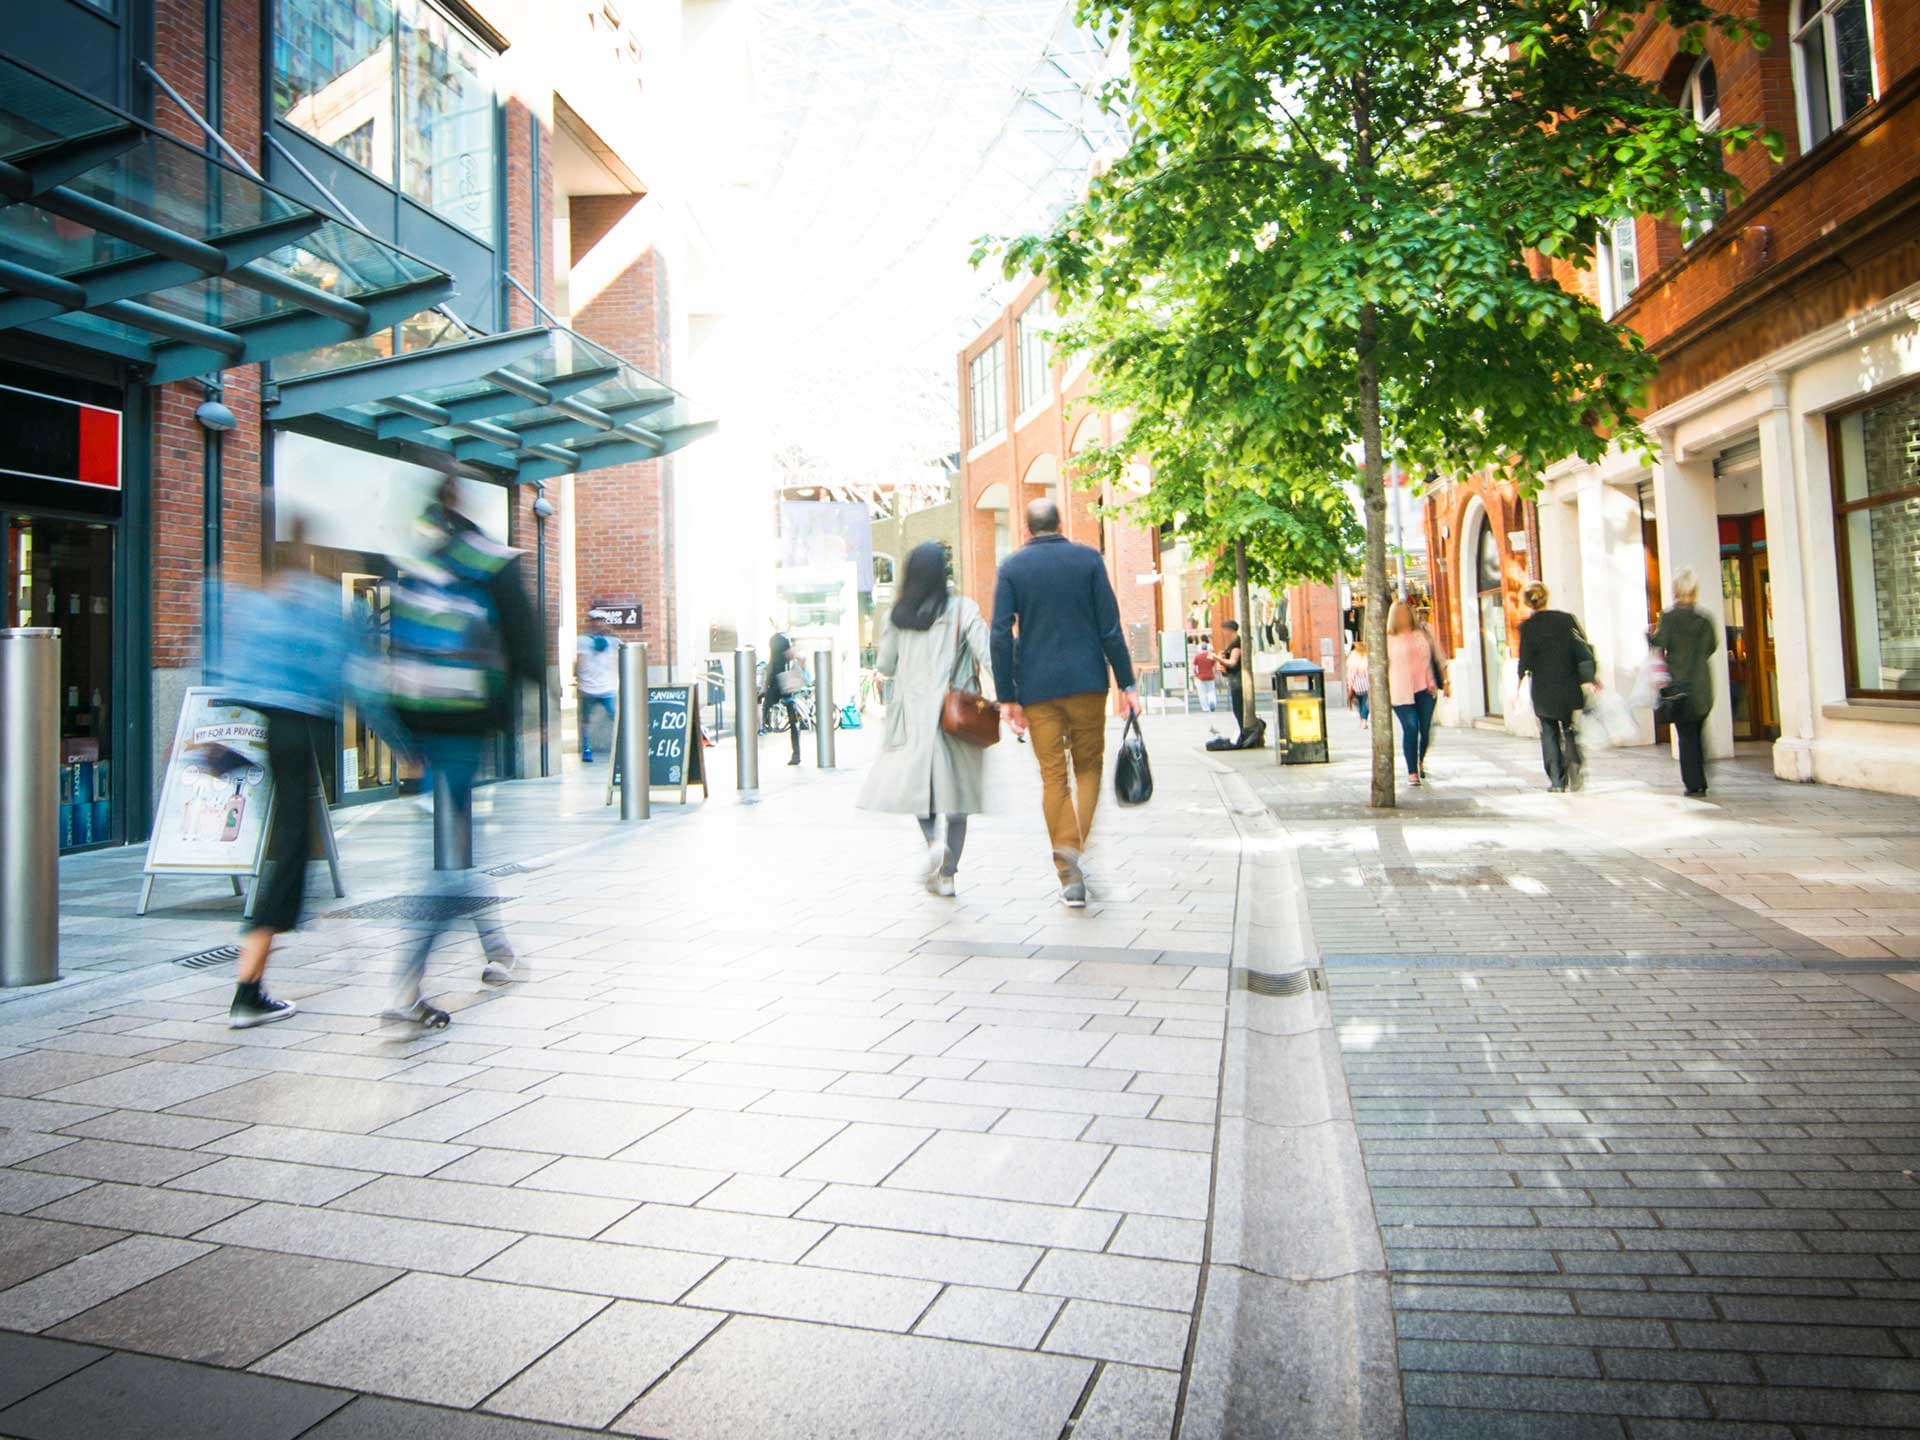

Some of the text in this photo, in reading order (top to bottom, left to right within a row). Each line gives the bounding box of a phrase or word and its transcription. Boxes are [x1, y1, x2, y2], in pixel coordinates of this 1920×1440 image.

[660, 711, 687, 730] £20
[208, 728, 224, 738] FOR
[225, 727, 232, 736] A
[656, 739, 681, 758] £16
